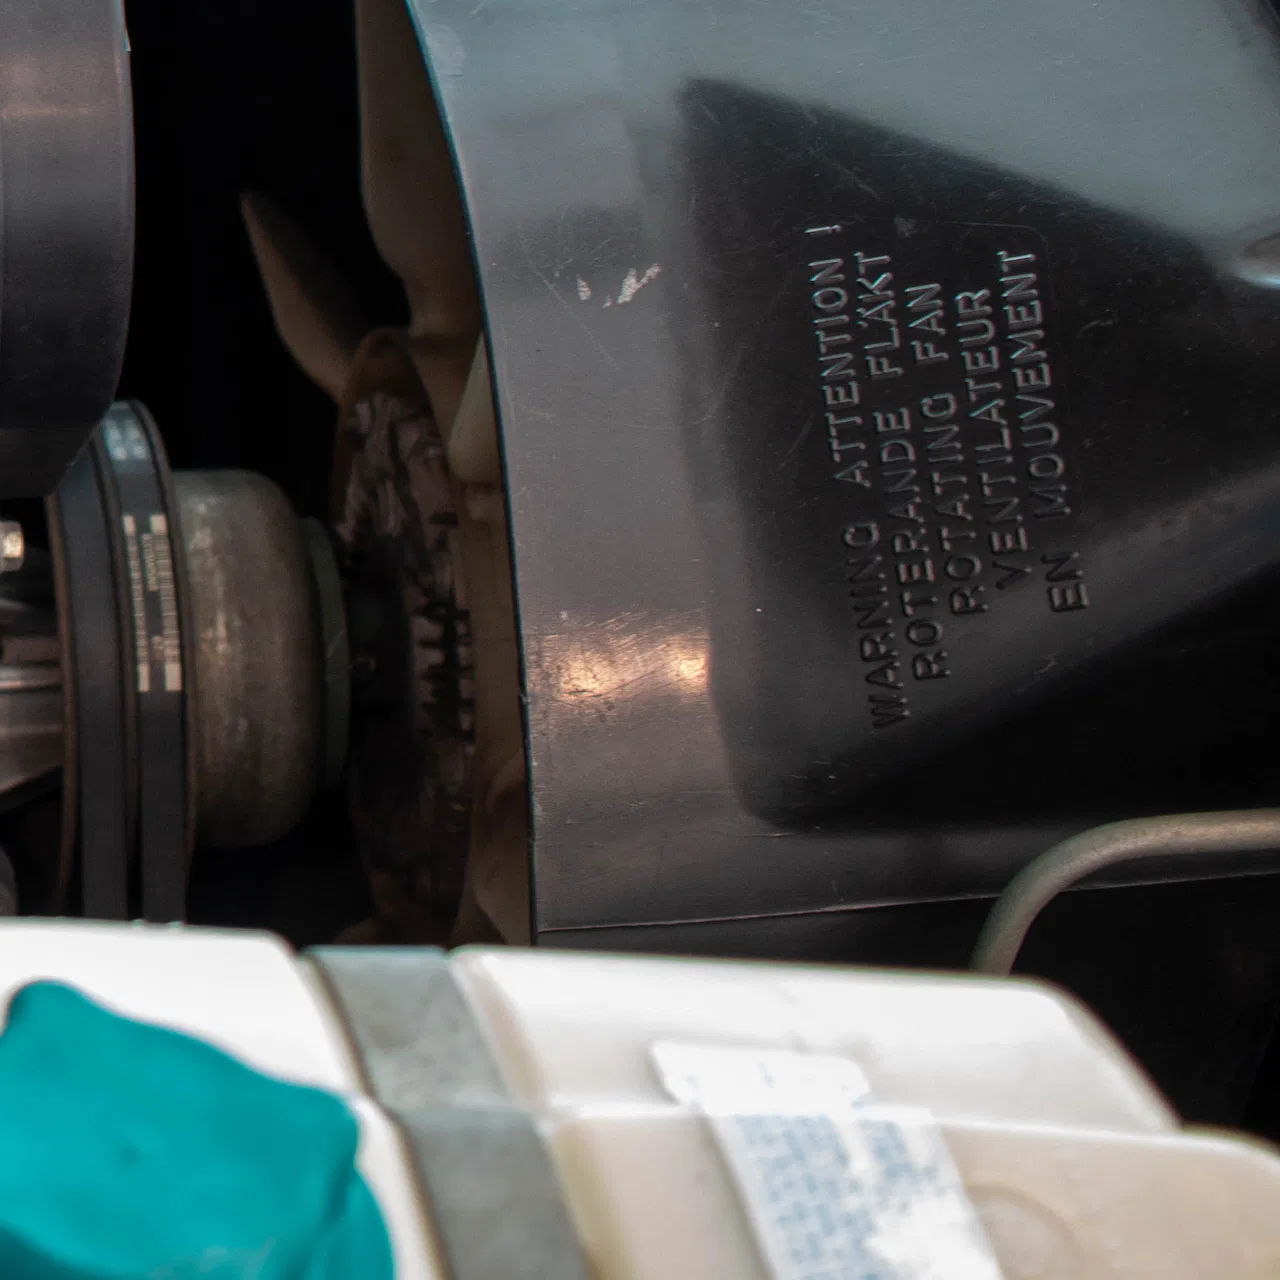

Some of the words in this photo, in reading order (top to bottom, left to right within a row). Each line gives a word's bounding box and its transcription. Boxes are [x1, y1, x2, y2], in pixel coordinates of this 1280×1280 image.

[807, 257, 873, 489] ATTENTION
[853, 250, 904, 382] FLÄKT
[904, 282, 950, 366] FAN
[996, 250, 1073, 520] MOUVEMENT
[875, 406, 952, 682] ROTERANDE
[921, 390, 989, 617] ROTATING
[954, 288, 1033, 591] VENTILATEUR
[843, 521, 912, 730] WARNING
[1041, 550, 1090, 615] EN
